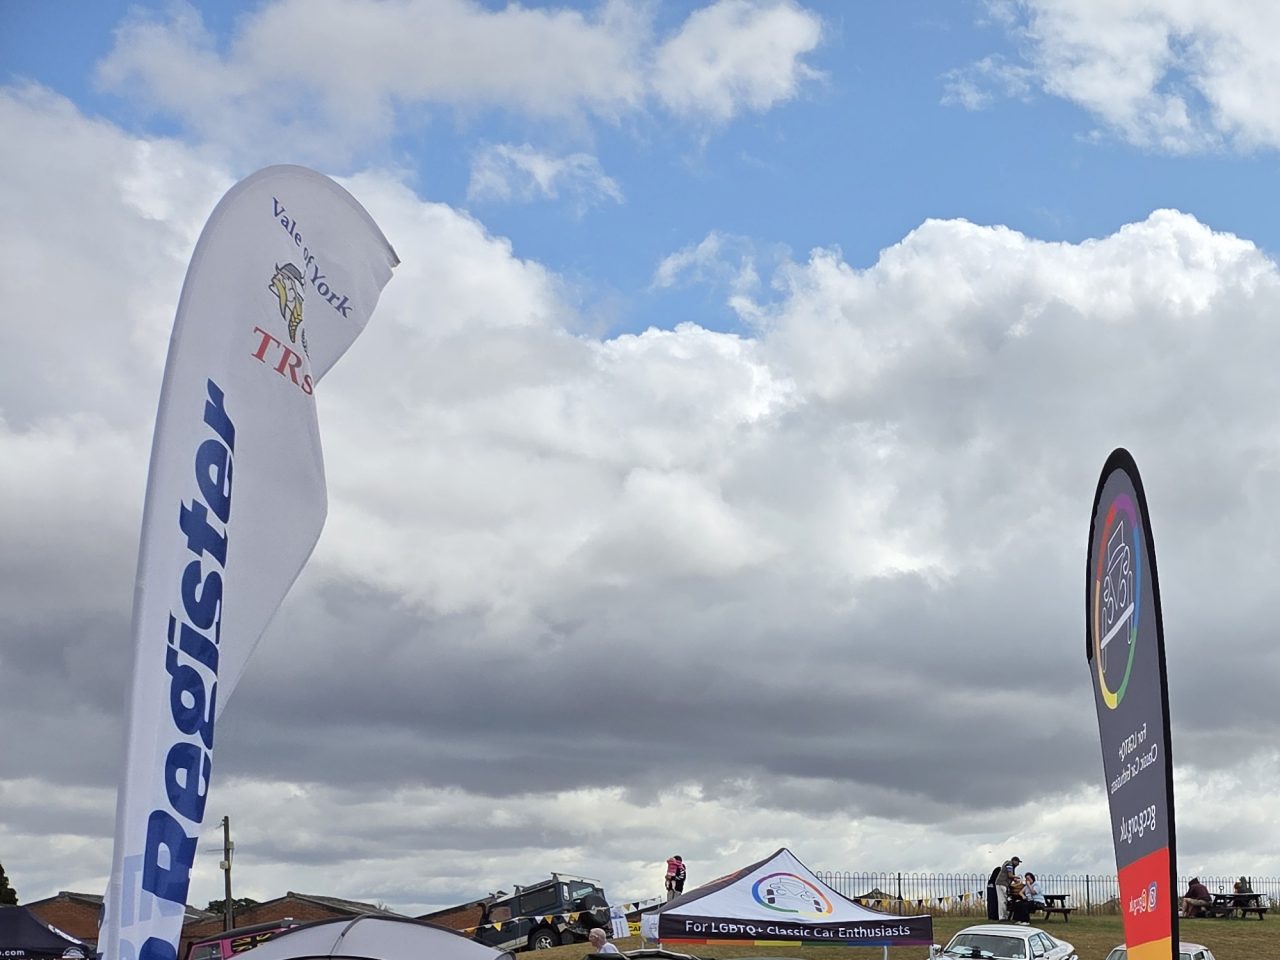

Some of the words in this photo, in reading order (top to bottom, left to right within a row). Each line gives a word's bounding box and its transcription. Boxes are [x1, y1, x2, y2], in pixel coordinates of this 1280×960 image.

[271, 197, 302, 247] Vale
[312, 267, 353, 318] York
[251, 326, 314, 396] TRs
[142, 377, 236, 906] Register
[685, 920, 708, 933] For
[711, 921, 764, 936] LGBTQ+
[766, 925, 811, 937] Classic
[813, 927, 834, 938] Car
[838, 925, 911, 938] Enthusiasts
